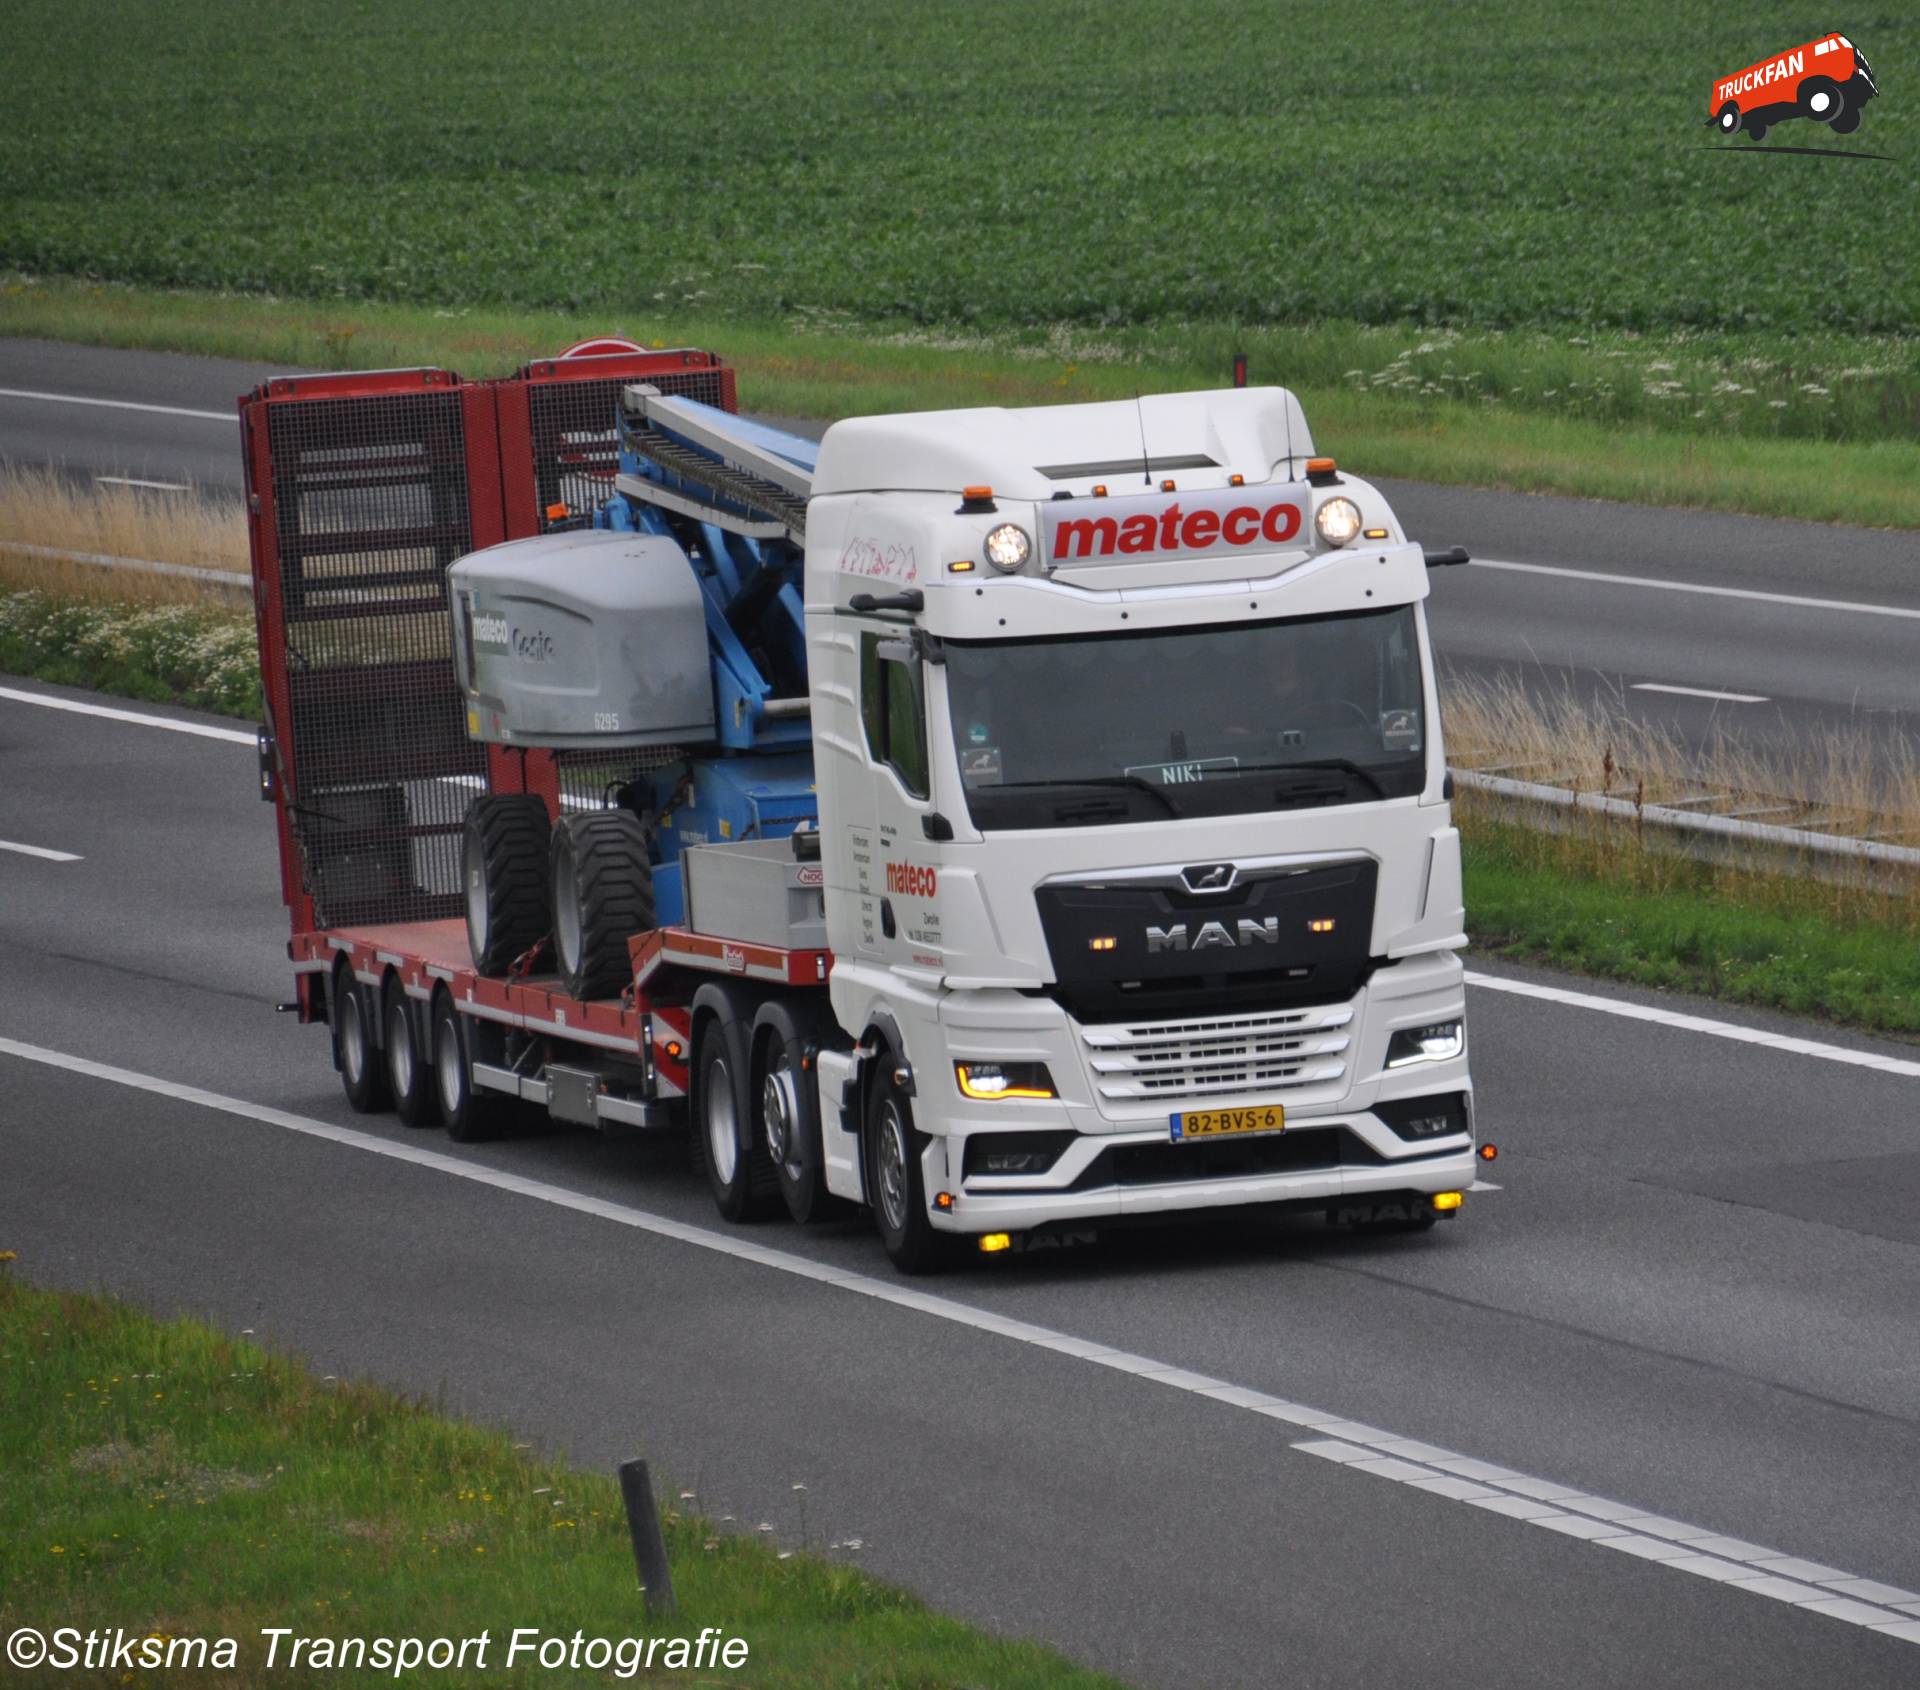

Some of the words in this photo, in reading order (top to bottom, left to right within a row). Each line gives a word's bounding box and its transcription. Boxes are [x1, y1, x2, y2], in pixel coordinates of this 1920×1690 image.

[1053, 501, 1302, 560] mateco
[472, 612, 508, 644] mateco
[594, 712, 620, 731] 6295
[1162, 763, 1203, 785] NIKI
[886, 859, 937, 898] mateco
[1146, 916, 1279, 954] MAN
[1187, 1109, 1276, 1134] 82-BVS-6
